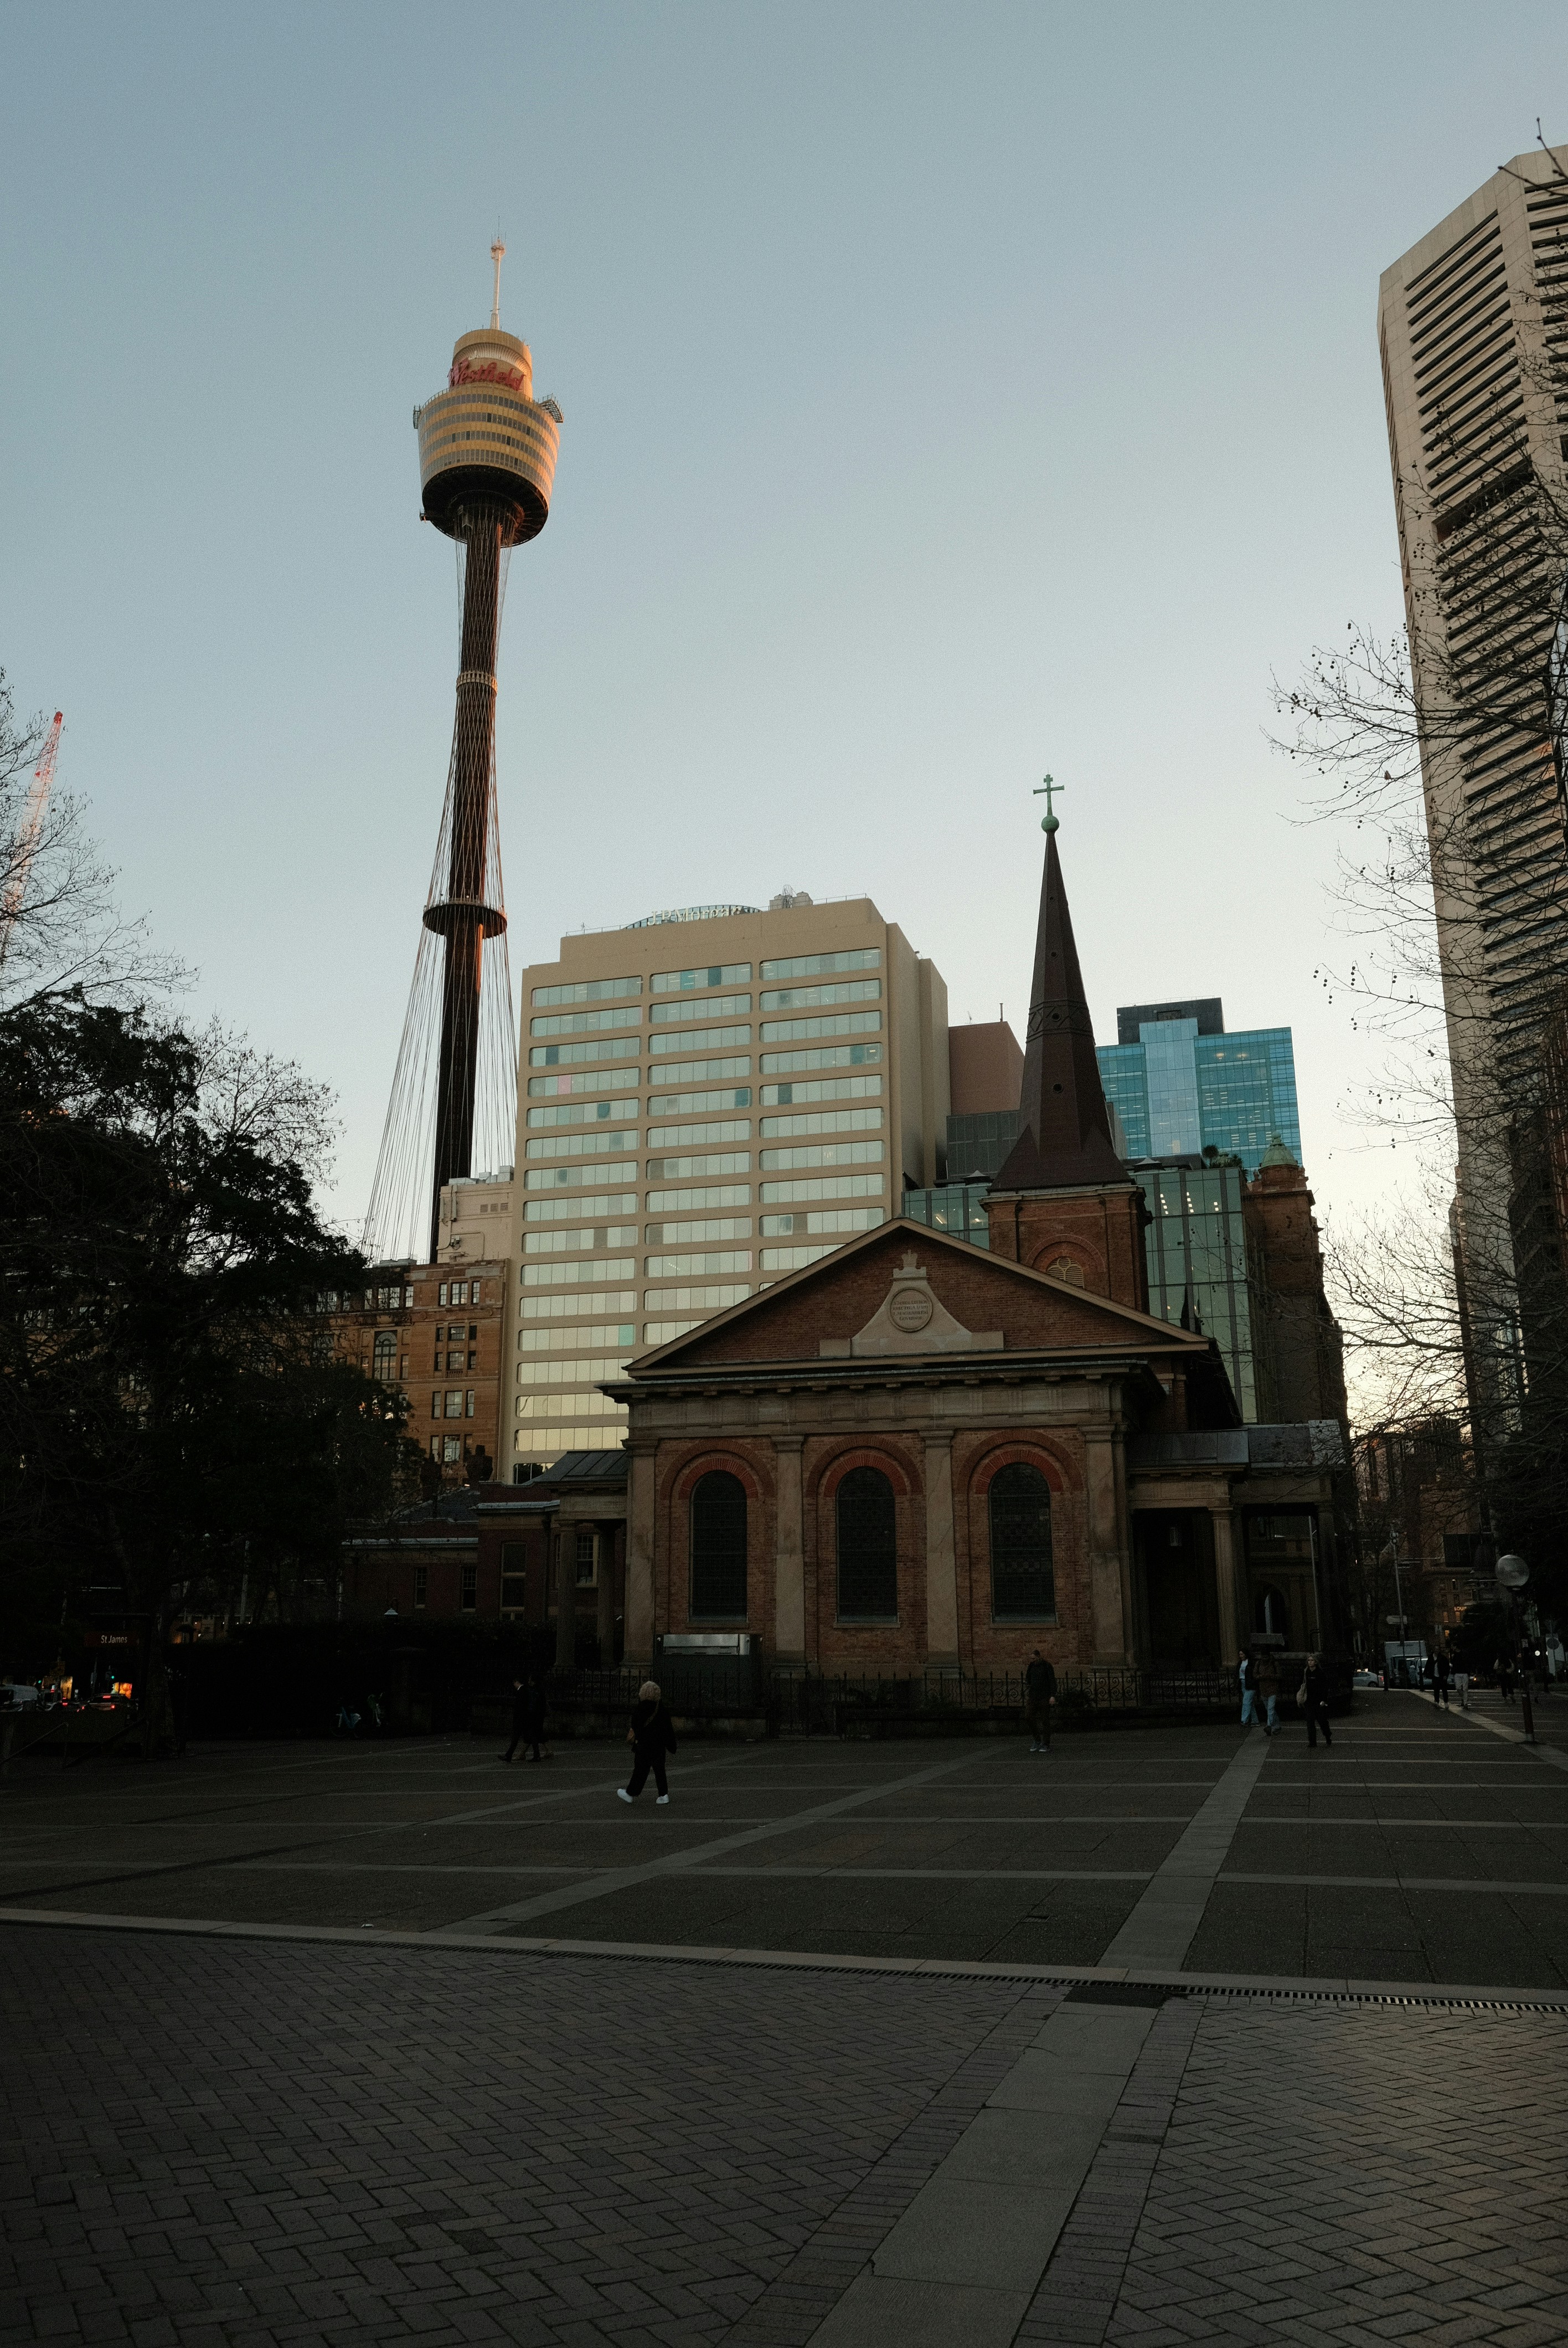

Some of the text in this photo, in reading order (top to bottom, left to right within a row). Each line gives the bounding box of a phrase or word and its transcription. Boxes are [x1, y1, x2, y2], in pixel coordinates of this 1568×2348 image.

[447, 358, 526, 391] Westfield
[101, 1635, 127, 1644] St James
